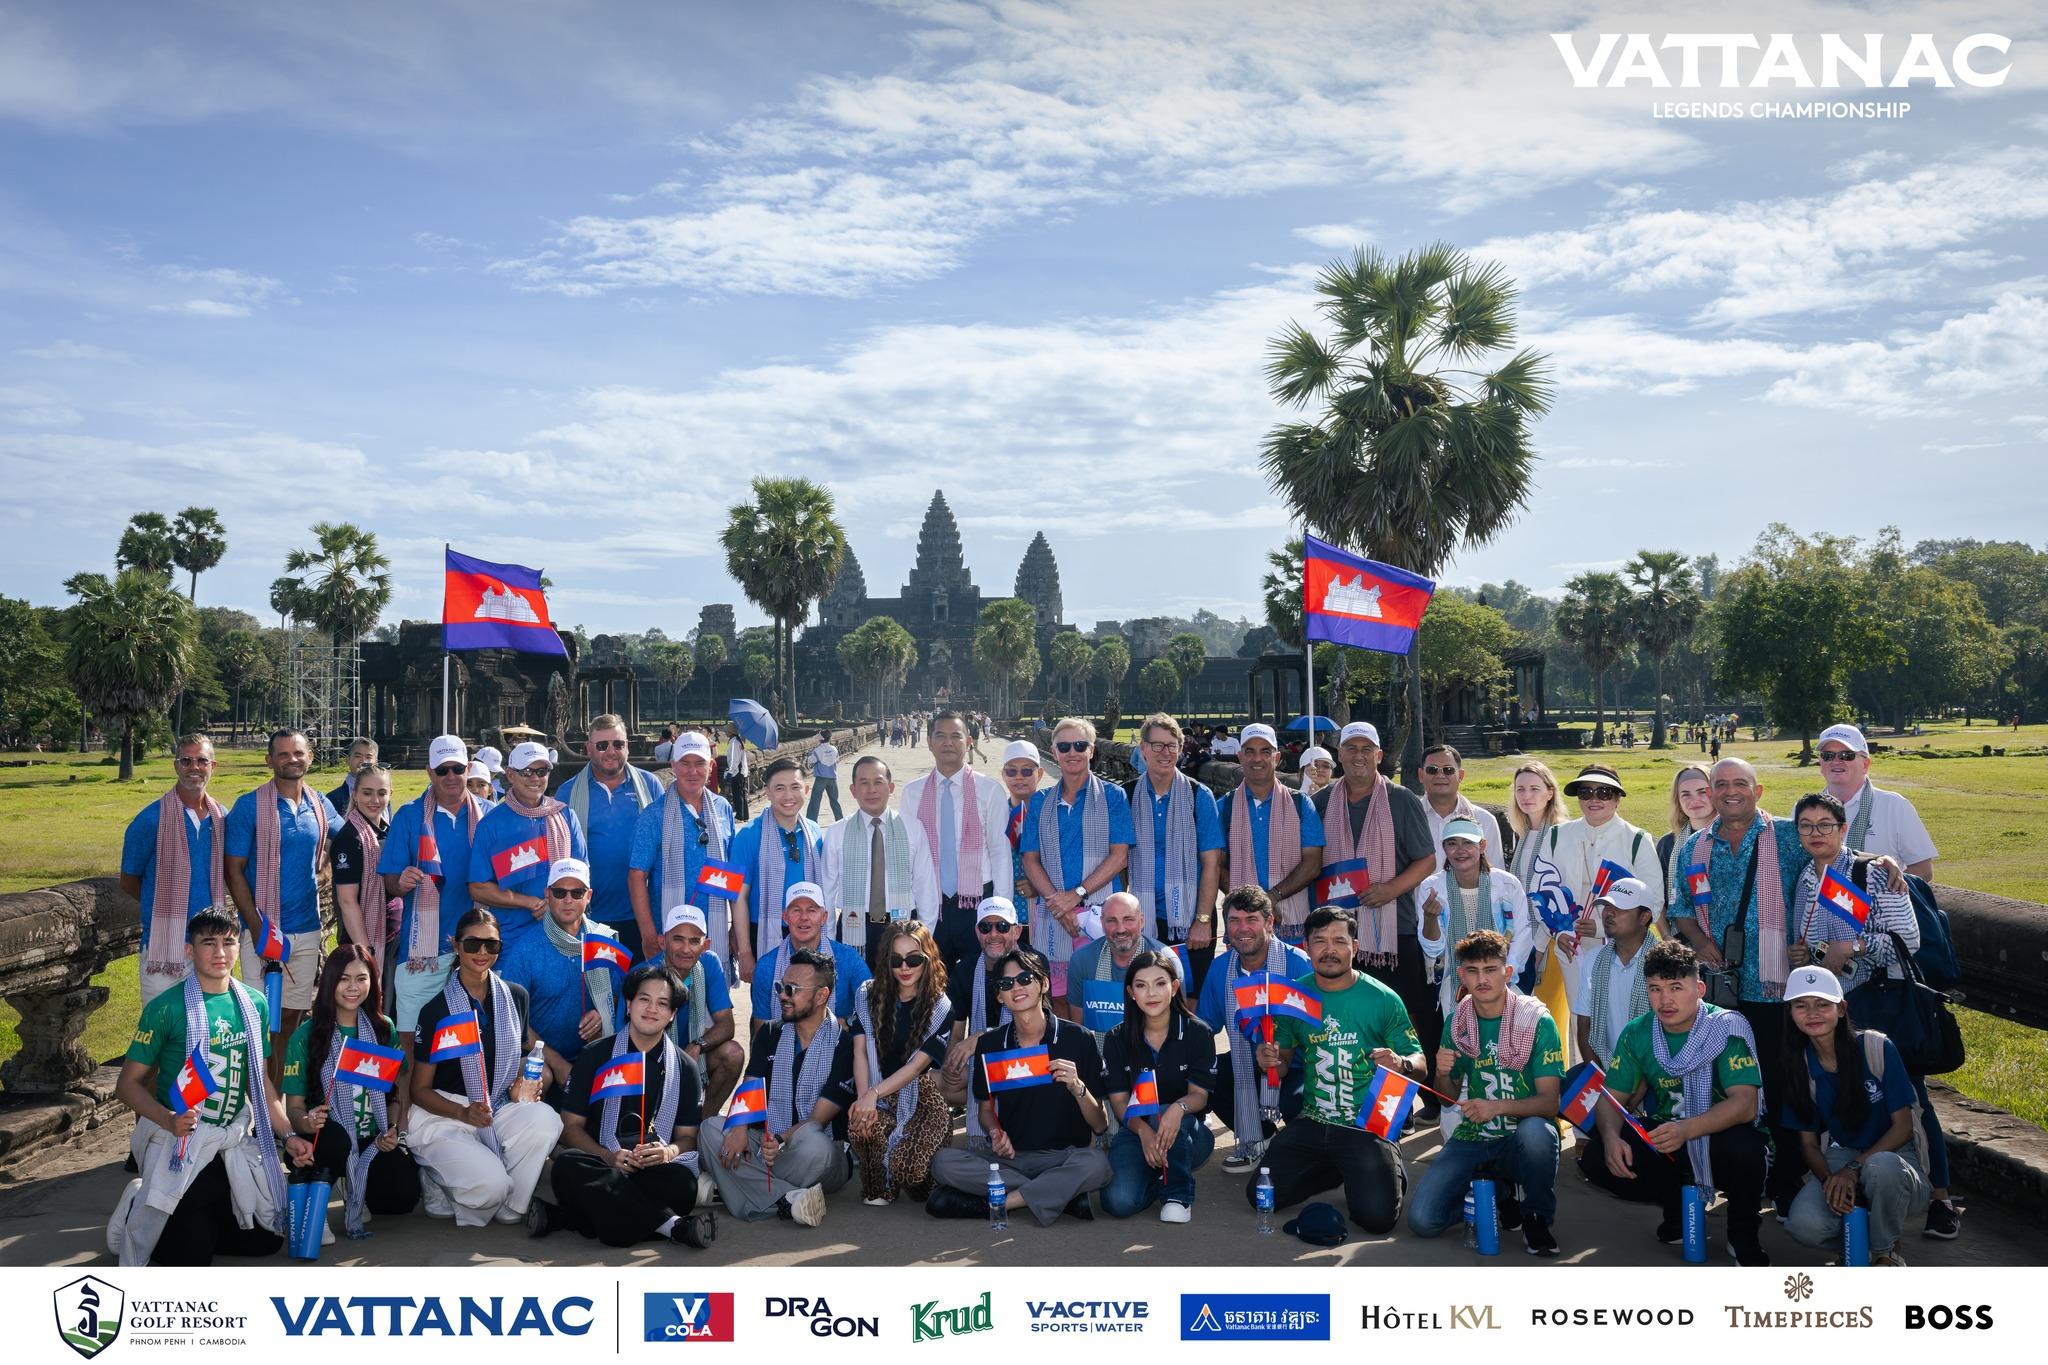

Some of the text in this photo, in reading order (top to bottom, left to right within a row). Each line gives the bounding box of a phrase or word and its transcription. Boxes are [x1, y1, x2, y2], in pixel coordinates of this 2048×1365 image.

[1086, 1001, 1124, 1011] VATTAN
[135, 1030, 154, 1044] ud
[1328, 1032, 1357, 1042] KUN
[1688, 1202, 1696, 1245] VATTANAC
